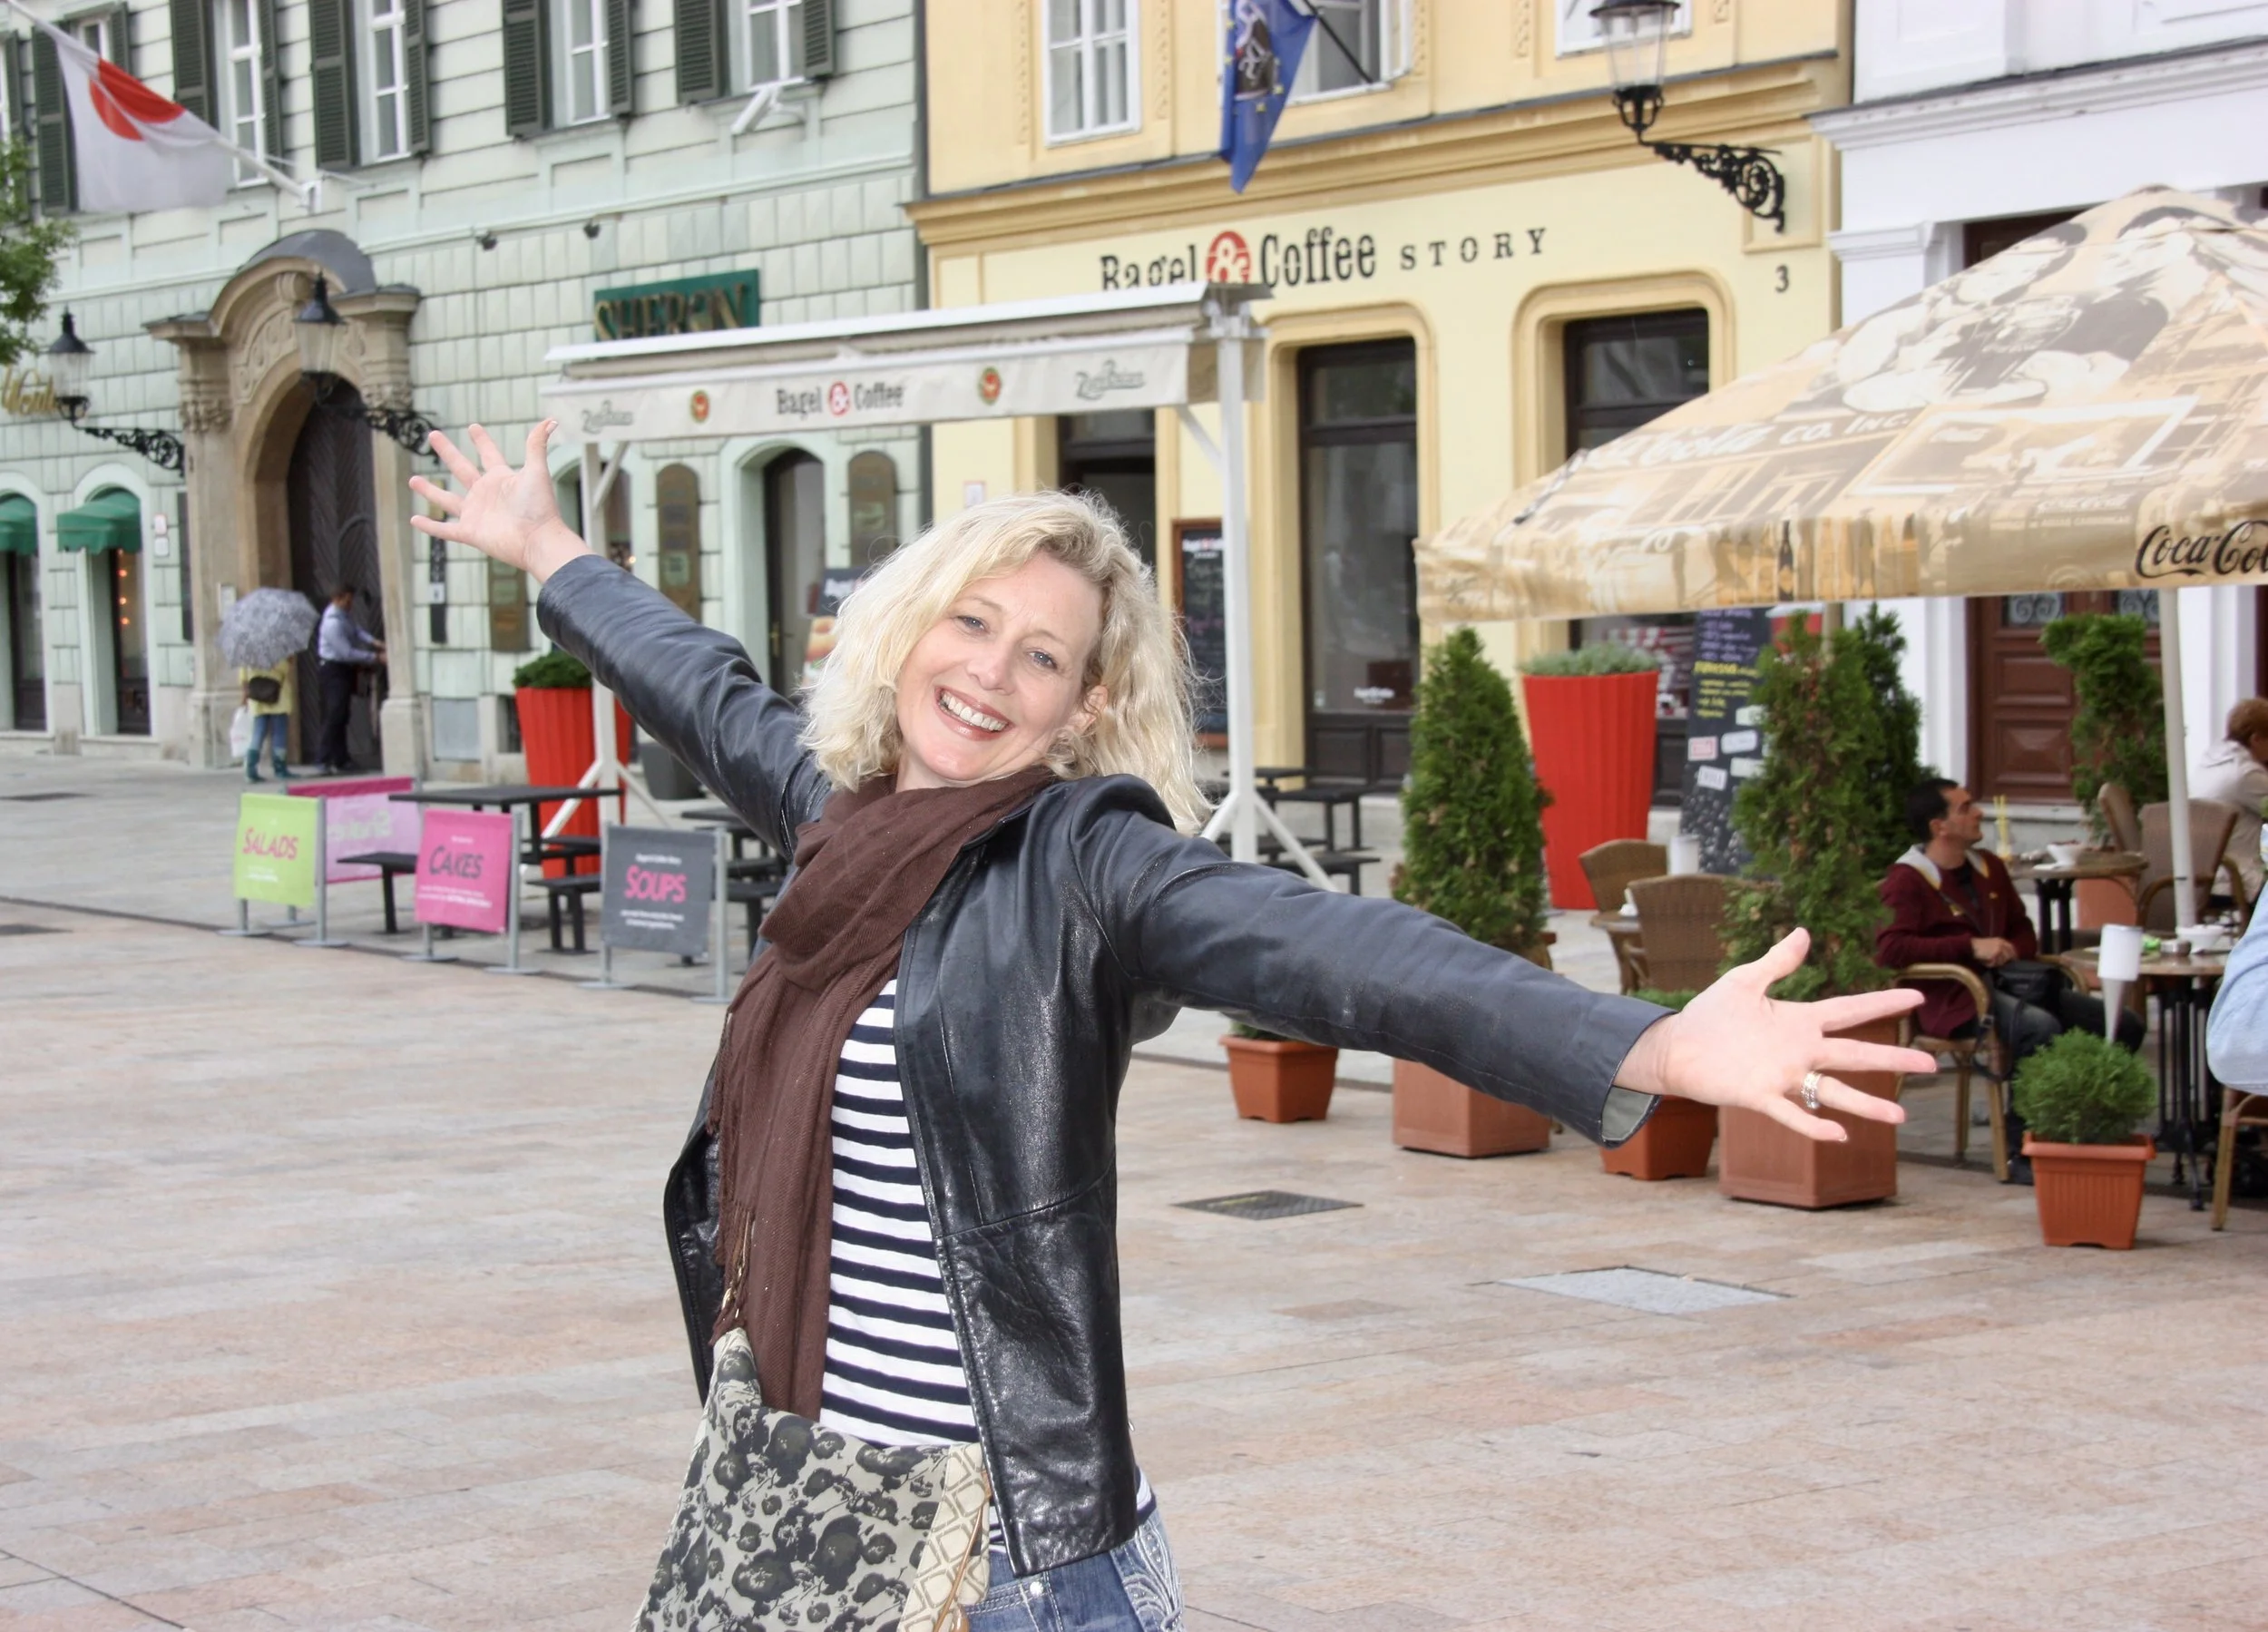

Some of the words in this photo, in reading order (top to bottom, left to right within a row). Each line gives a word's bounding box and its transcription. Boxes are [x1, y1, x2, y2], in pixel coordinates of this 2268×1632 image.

[1260, 226, 1375, 288] Coffee
[1400, 227, 1546, 270] STORY
[1774, 264, 1789, 293] 3
[776, 386, 822, 421] Bagel
[854, 381, 904, 411] Coffee
[242, 826, 298, 861] SALADS
[429, 845, 484, 880] CAKES
[624, 864, 687, 904] SOUPS
